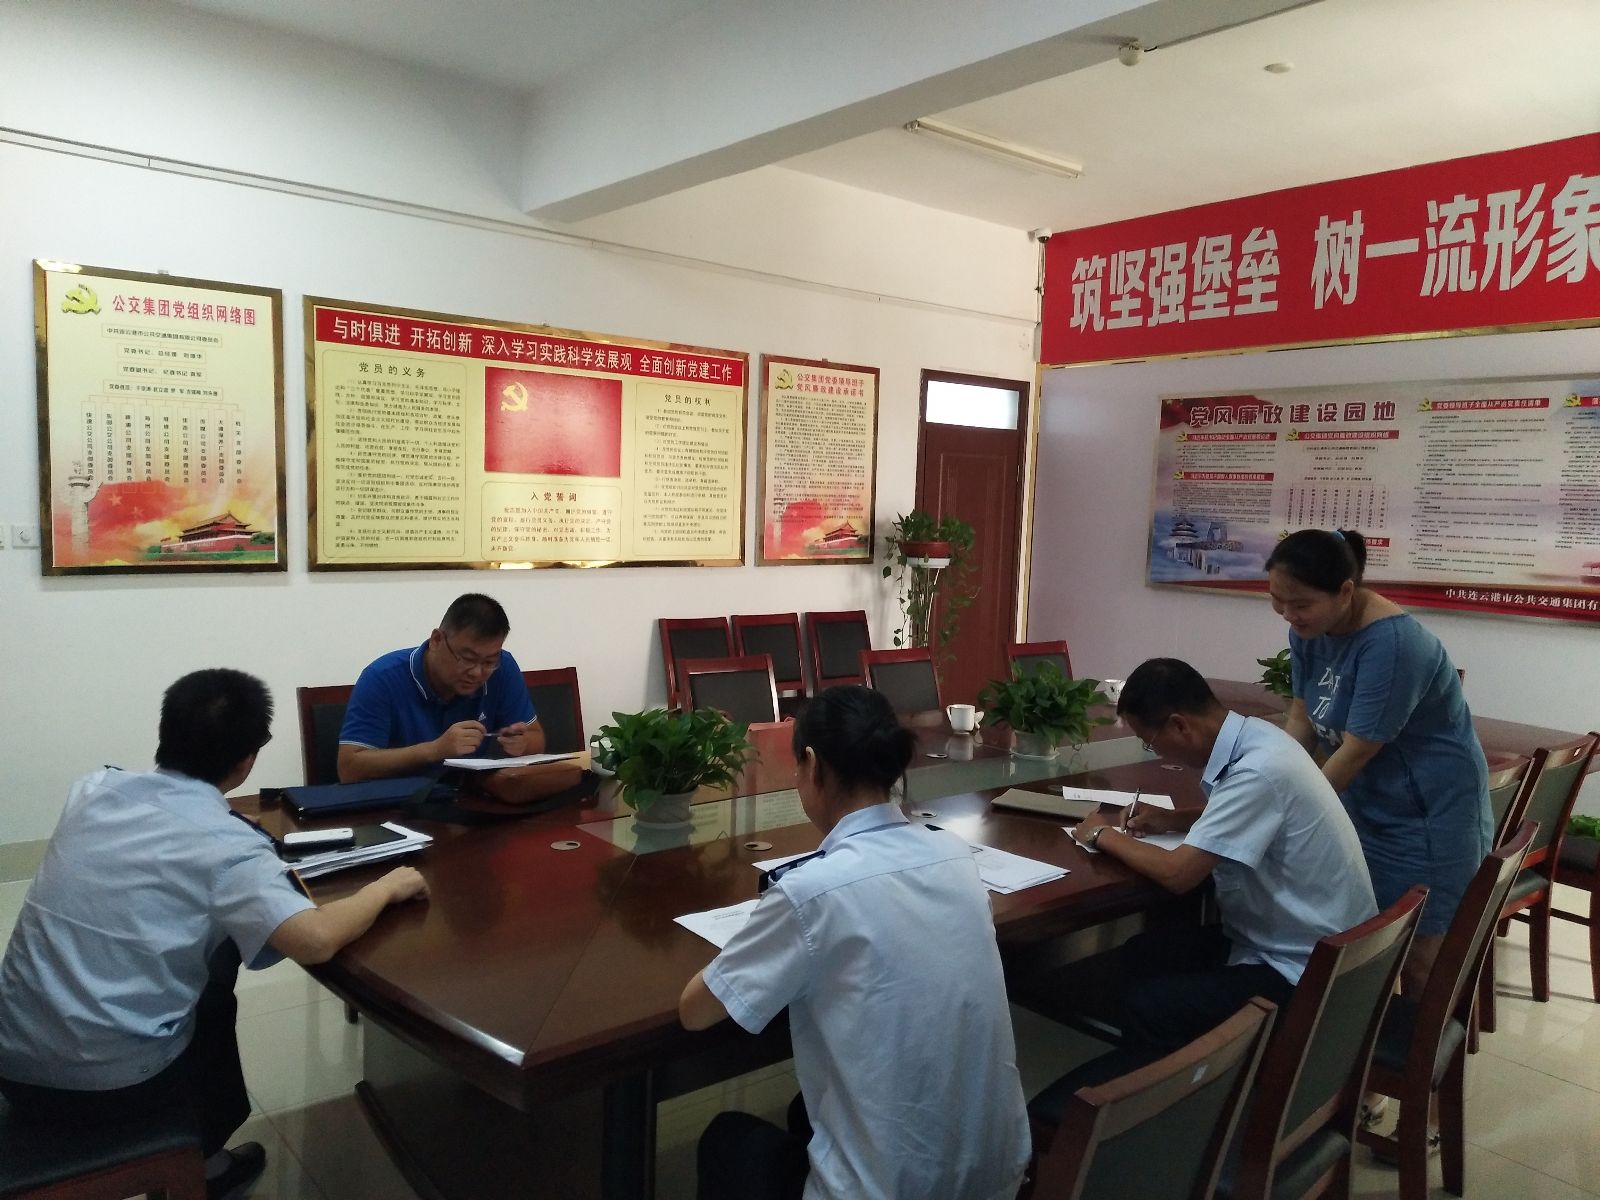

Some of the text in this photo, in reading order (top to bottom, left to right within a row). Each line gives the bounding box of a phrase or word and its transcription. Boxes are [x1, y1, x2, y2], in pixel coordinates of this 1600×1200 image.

[1070, 173, 1600, 334] 筑坚强堡垒 树一流形象
[112, 294, 256, 326] 公交集团党组织网络图
[333, 316, 733, 382] 与时俱进 开拓创新 深入学习实践科学发展观 全面创新党建工作
[358, 362, 426, 378] 党员的义务
[664, 394, 712, 406] 党员的权利
[1189, 400, 1397, 428] 党风廉政建设园地
[530, 491, 578, 502] 入党誓词
[1445, 588, 1598, 611] 中共连云港市公共交通集团有
